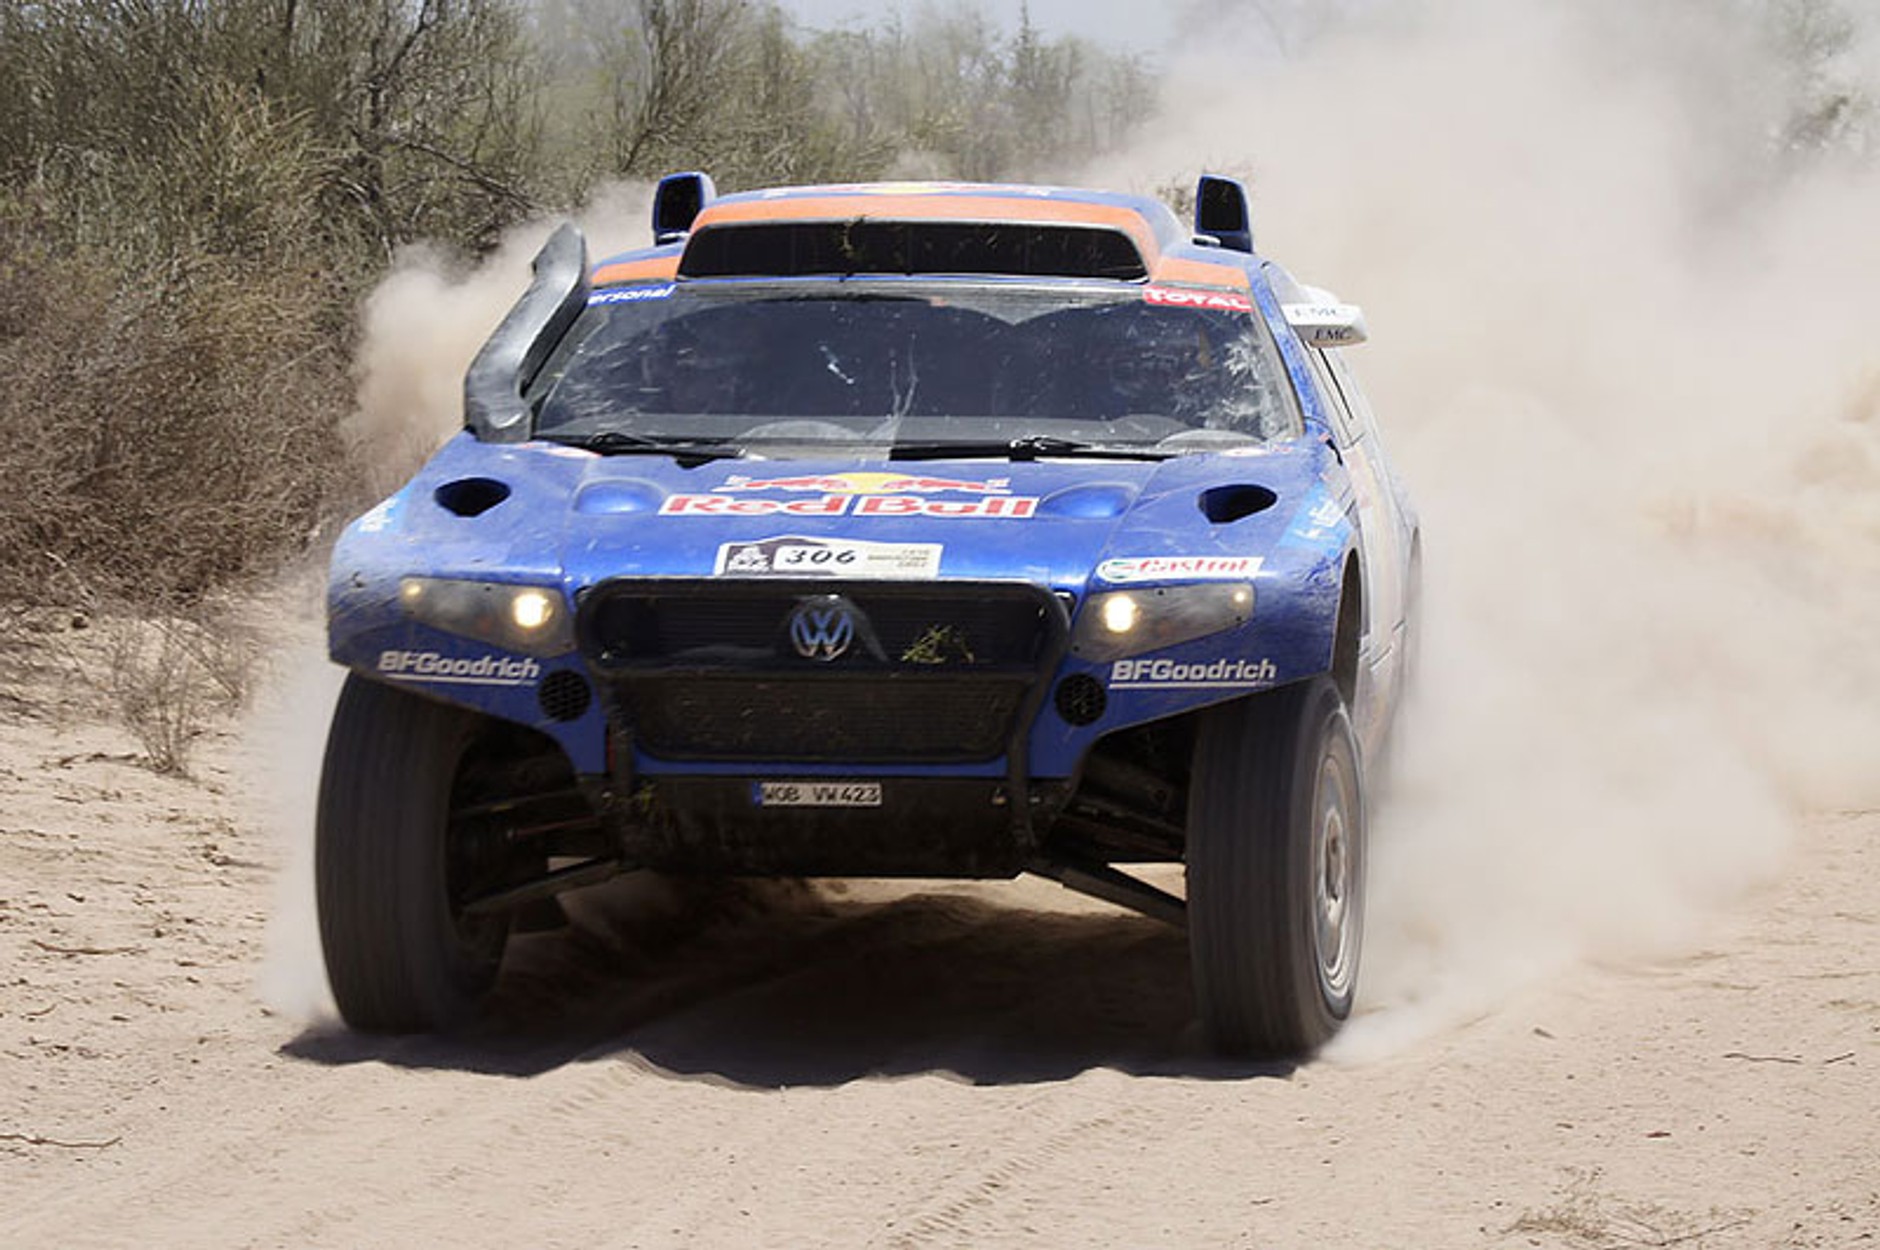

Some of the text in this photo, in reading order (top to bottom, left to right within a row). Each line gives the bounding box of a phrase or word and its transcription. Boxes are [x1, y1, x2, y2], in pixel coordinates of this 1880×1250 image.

[588, 283, 677, 305] ersonal
[1144, 289, 1250, 310] TOTAL
[1314, 327, 1351, 341] EMC
[660, 494, 1039, 517] Red Bull
[785, 549, 856, 564] 306
[1137, 560, 1250, 574] Castrol
[377, 650, 541, 678] BFGoodrich
[1110, 658, 1277, 680] BFGoodrich
